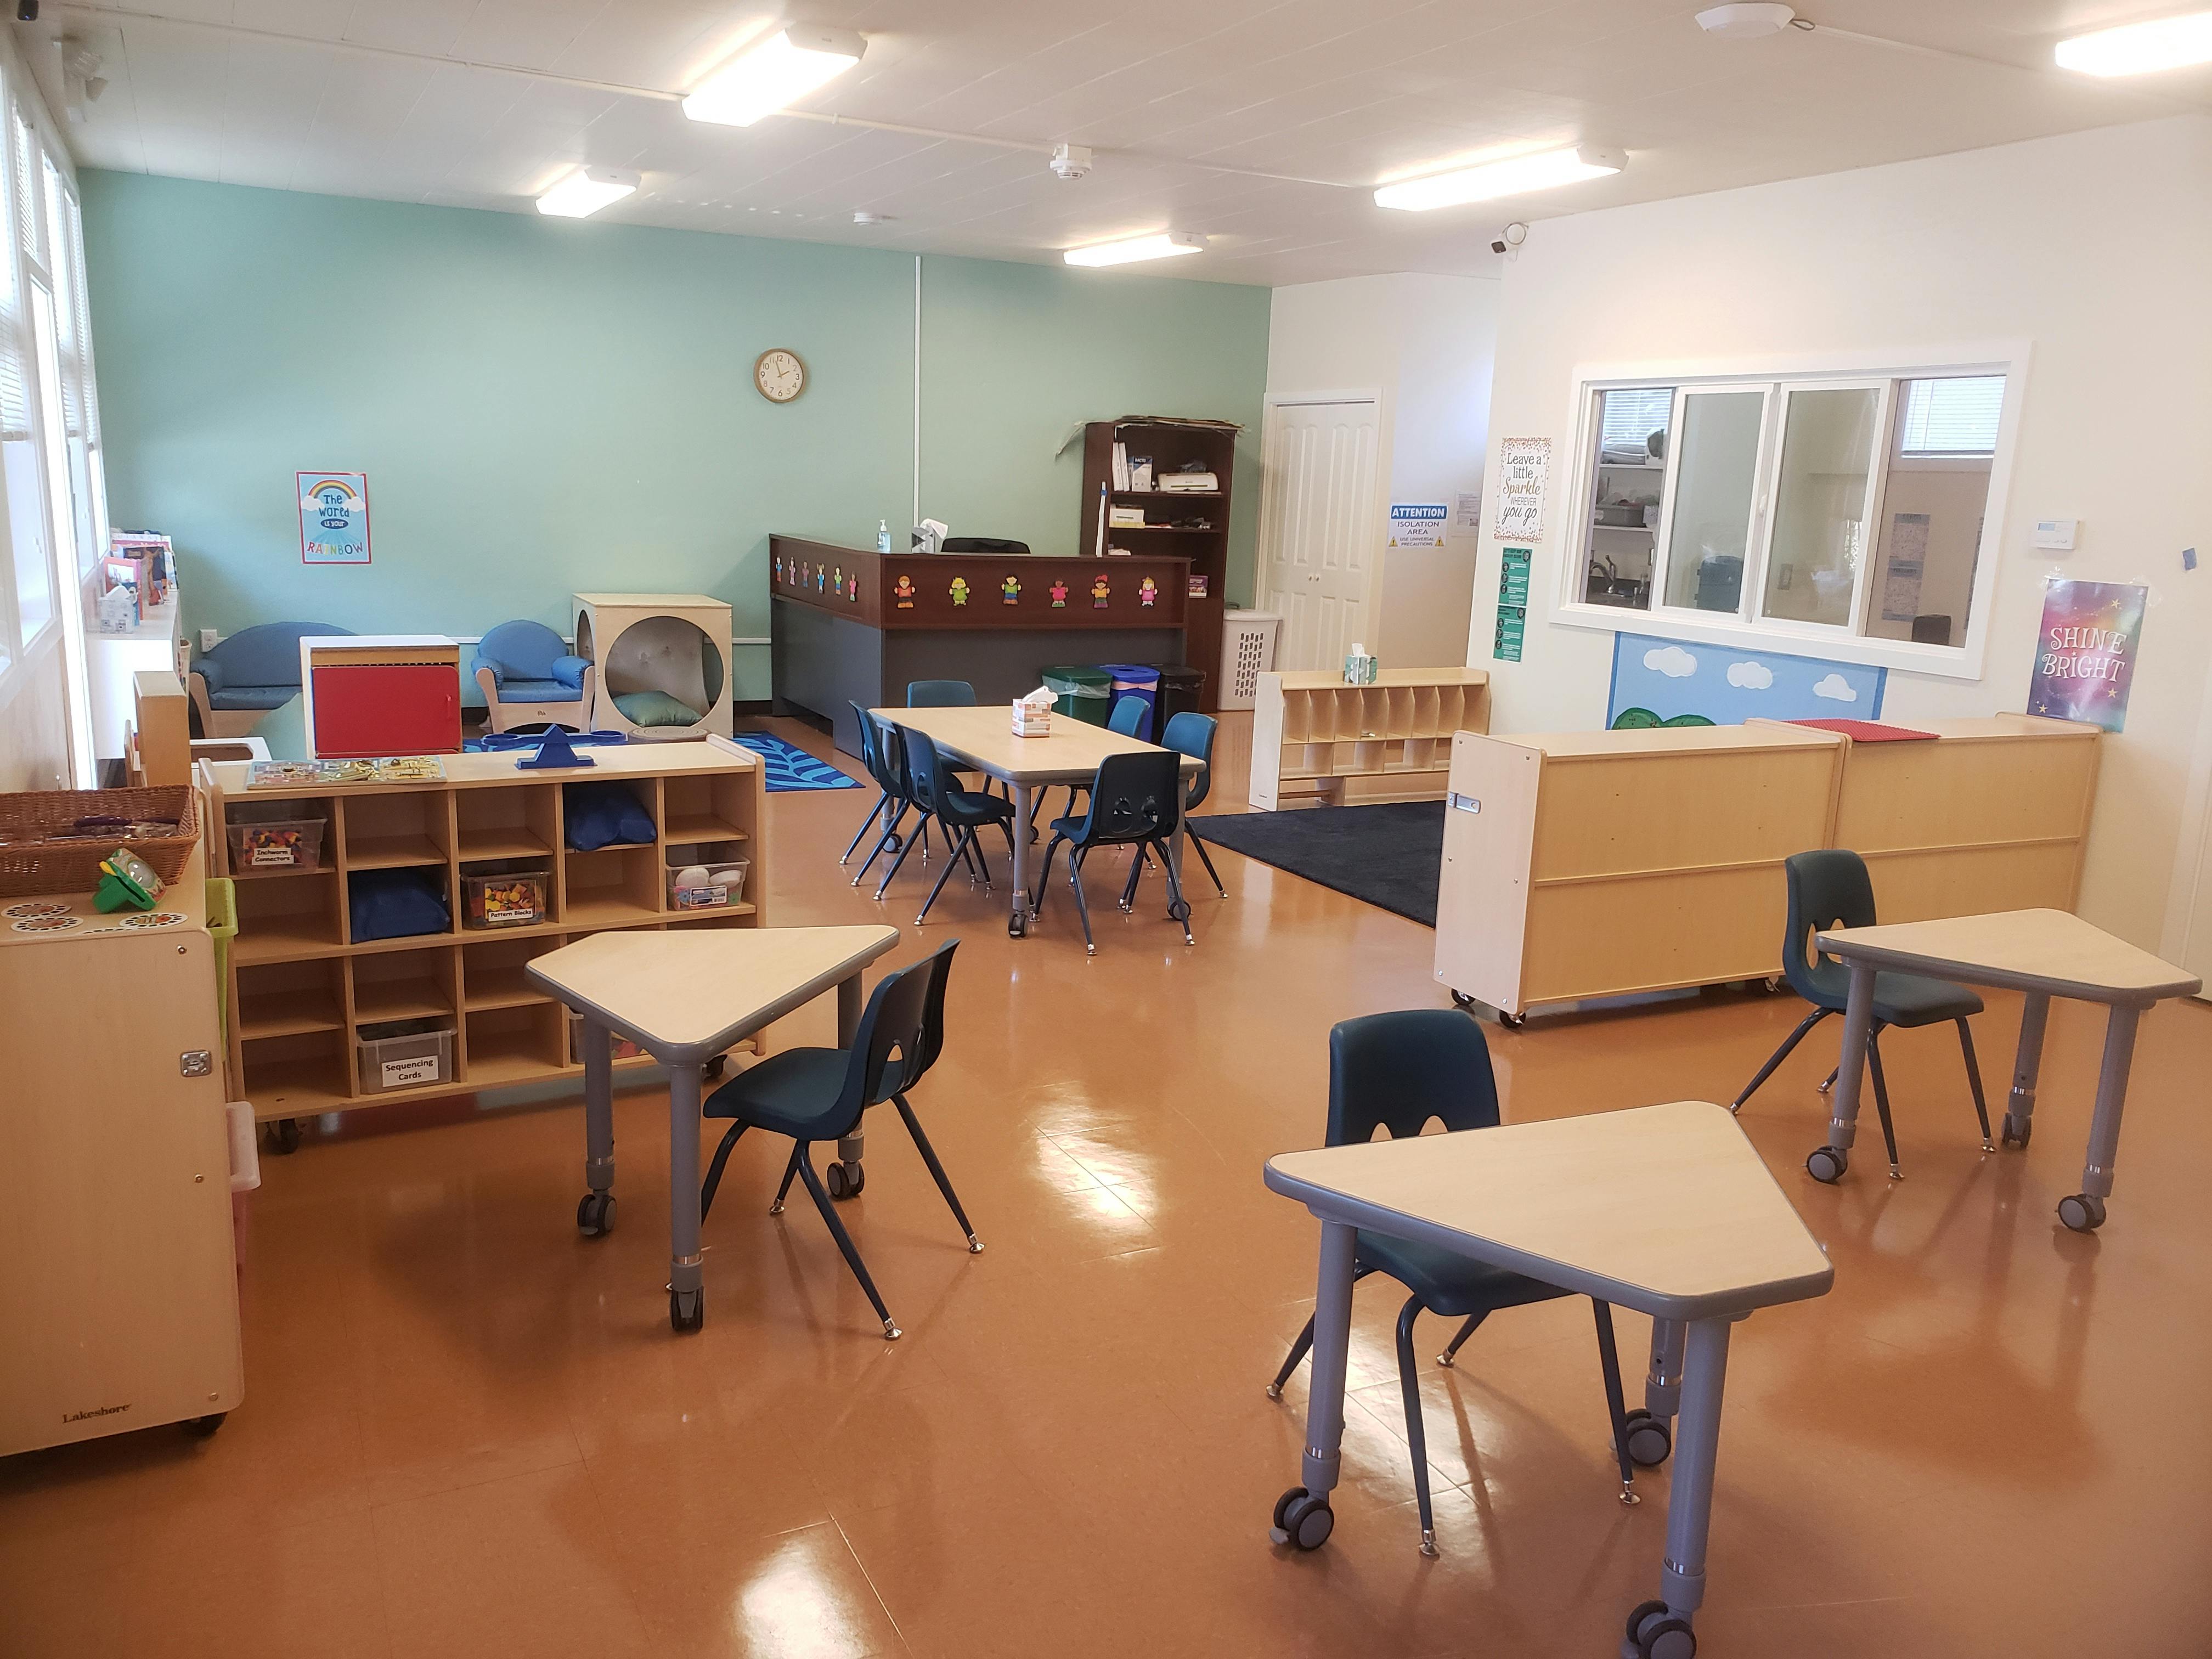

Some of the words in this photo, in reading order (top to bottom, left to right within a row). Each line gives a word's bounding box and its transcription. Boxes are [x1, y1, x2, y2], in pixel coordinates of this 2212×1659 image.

[1506, 453, 1534, 465] Leave
[1536, 456, 1541, 465] a
[1513, 466, 1533, 479] little
[1503, 476, 1541, 499] Sparkle
[323, 494, 342, 504] The
[1510, 496, 1536, 506] WHEREVER
[1392, 507, 1444, 517] ATTENTION
[1502, 506, 1522, 525] you
[1522, 507, 1537, 526] go
[307, 541, 363, 555] RAINBOW
[2050, 627, 2128, 655] SHINE
[2042, 651, 2125, 682] BRIGHT
[386, 1060, 433, 1071] Sequencing
[398, 1071, 422, 1081] Cards
[63, 1404, 131, 1423] Lakeshore
